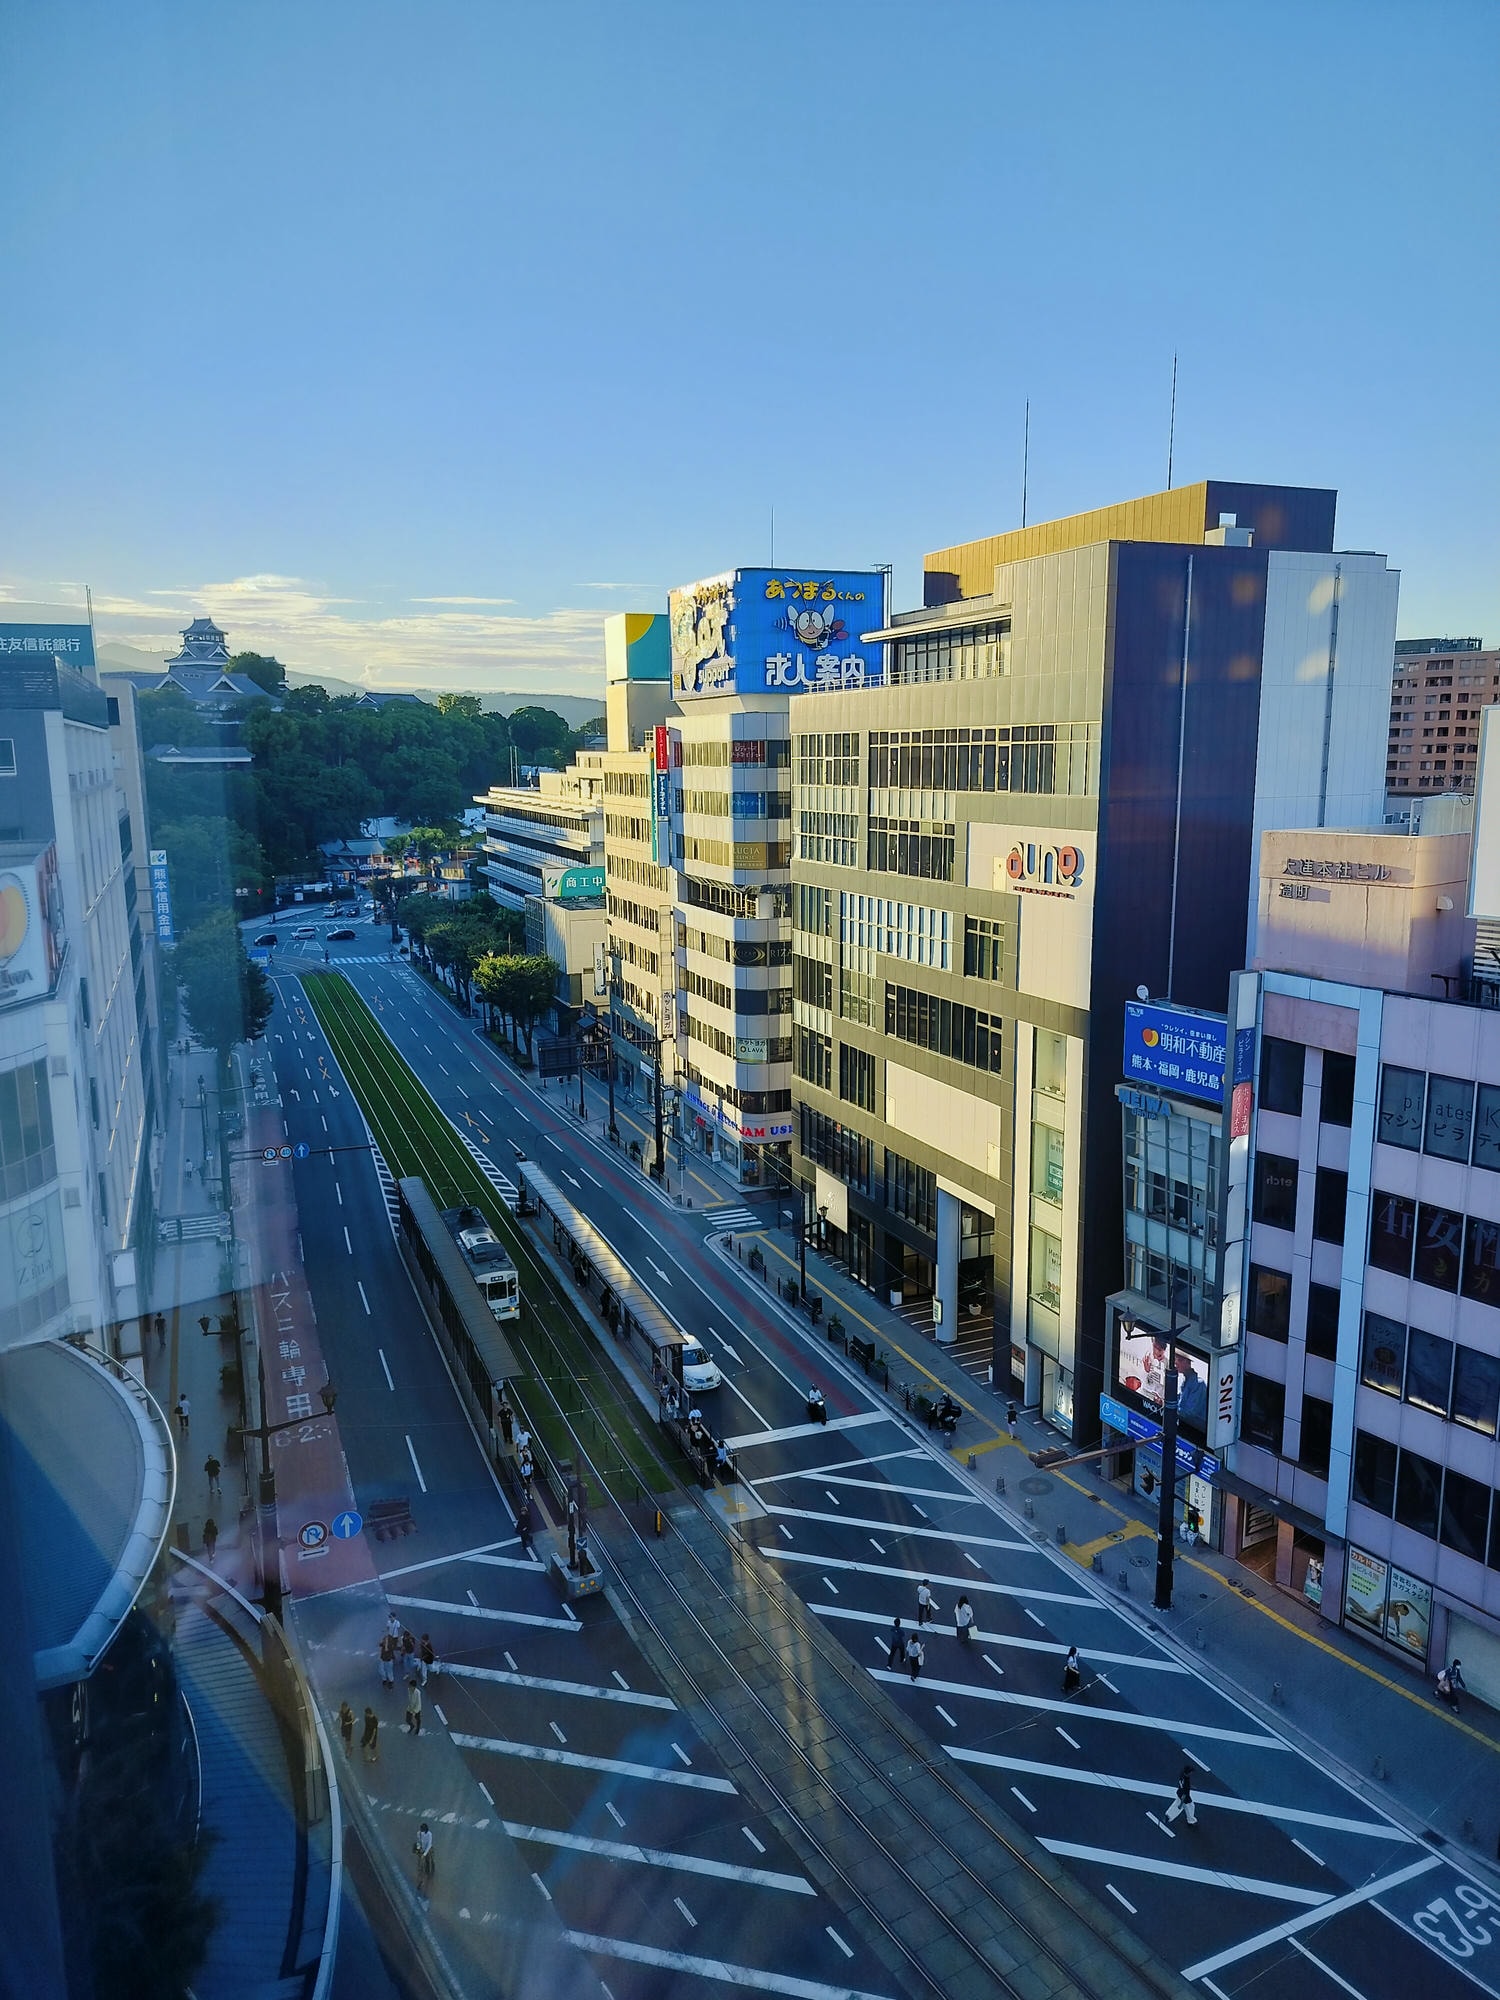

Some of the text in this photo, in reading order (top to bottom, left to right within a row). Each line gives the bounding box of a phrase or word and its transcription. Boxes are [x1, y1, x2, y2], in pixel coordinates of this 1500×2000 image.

[765, 578, 865, 600] あつまるくんの
[0, 637, 80, 651] 住友信託銀行
[766, 652, 865, 686] 求人案内
[1160, 1032, 1226, 1065] 明和不動産
[740, 1125, 765, 1138] JAM
